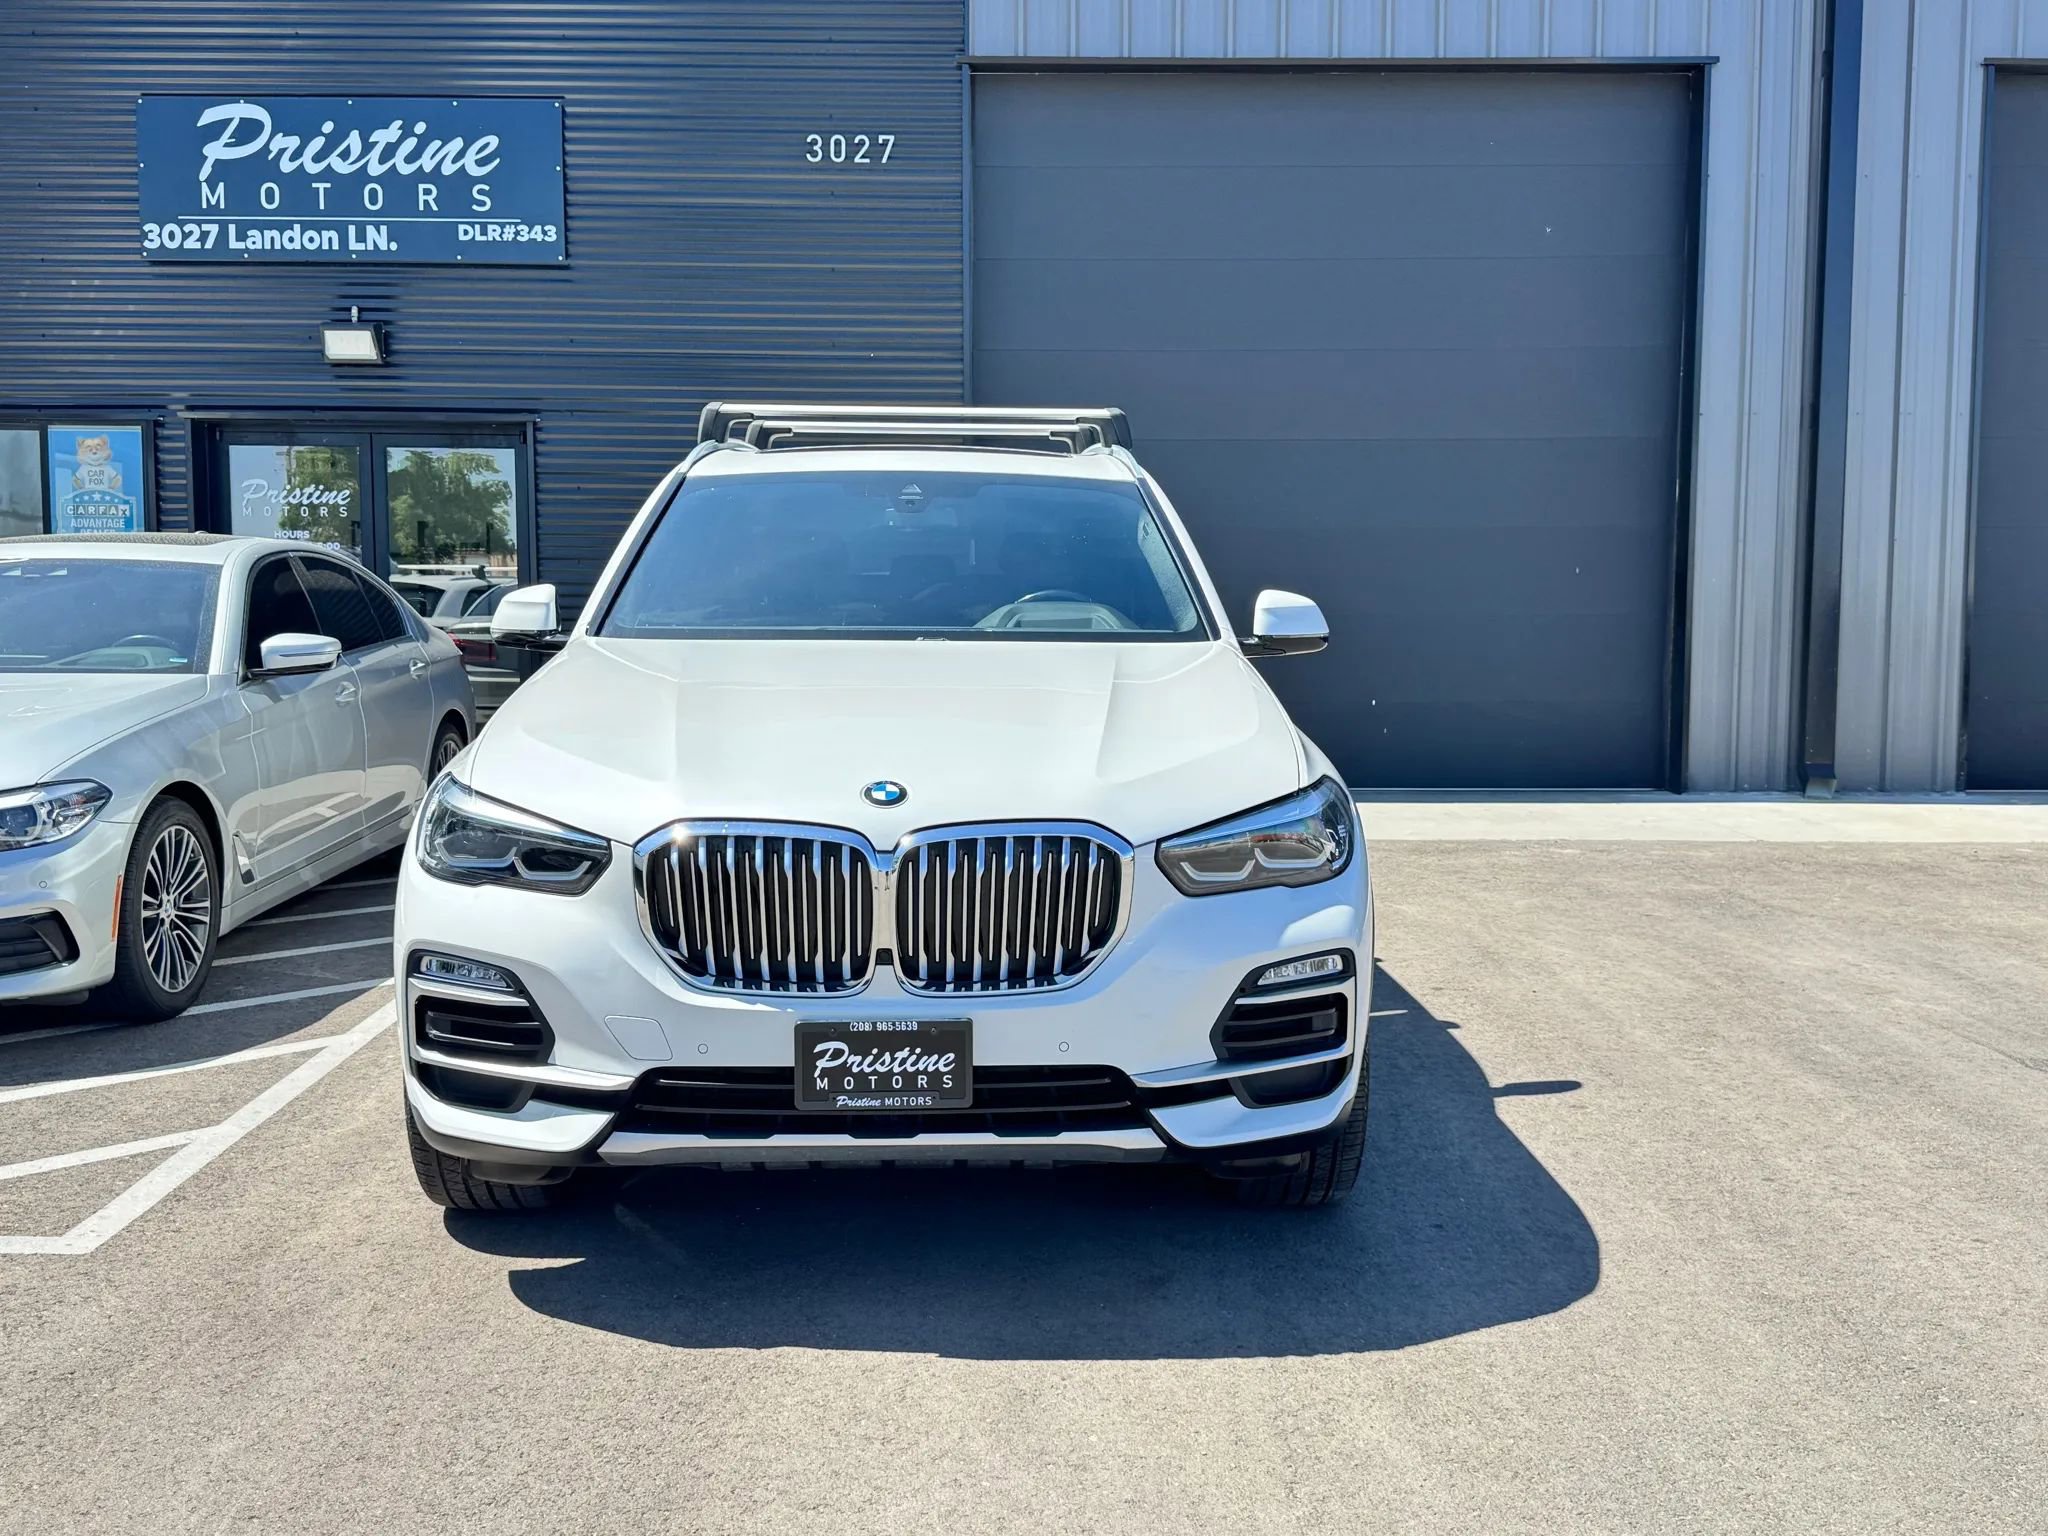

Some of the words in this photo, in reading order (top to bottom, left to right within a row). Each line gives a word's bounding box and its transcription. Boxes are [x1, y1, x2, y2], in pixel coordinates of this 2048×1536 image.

[196, 102, 501, 182] Pristine
[805, 133, 896, 164] 3027
[200, 182, 493, 212] MOTORS
[142, 223, 220, 250] 3027
[228, 223, 339, 251] Landon
[348, 224, 399, 252] LN.
[457, 223, 558, 243] DLR#343
[87, 469, 105, 478] CAR
[88, 478, 105, 486] FOX
[241, 478, 351, 508] Pristine
[66, 504, 129, 517] CARFAX
[242, 506, 349, 518] MOTORS
[70, 518, 126, 528] ADVANTAGE
[274, 530, 311, 539] HOURS
[849, 1021, 873, 1032] (208)
[876, 1021, 919, 1032] 965-5639
[813, 1040, 956, 1078] Pristine
[816, 1074, 953, 1091] MOTORS
[836, 1095, 882, 1109] Pristine
[884, 1096, 932, 1106] MOTORS
